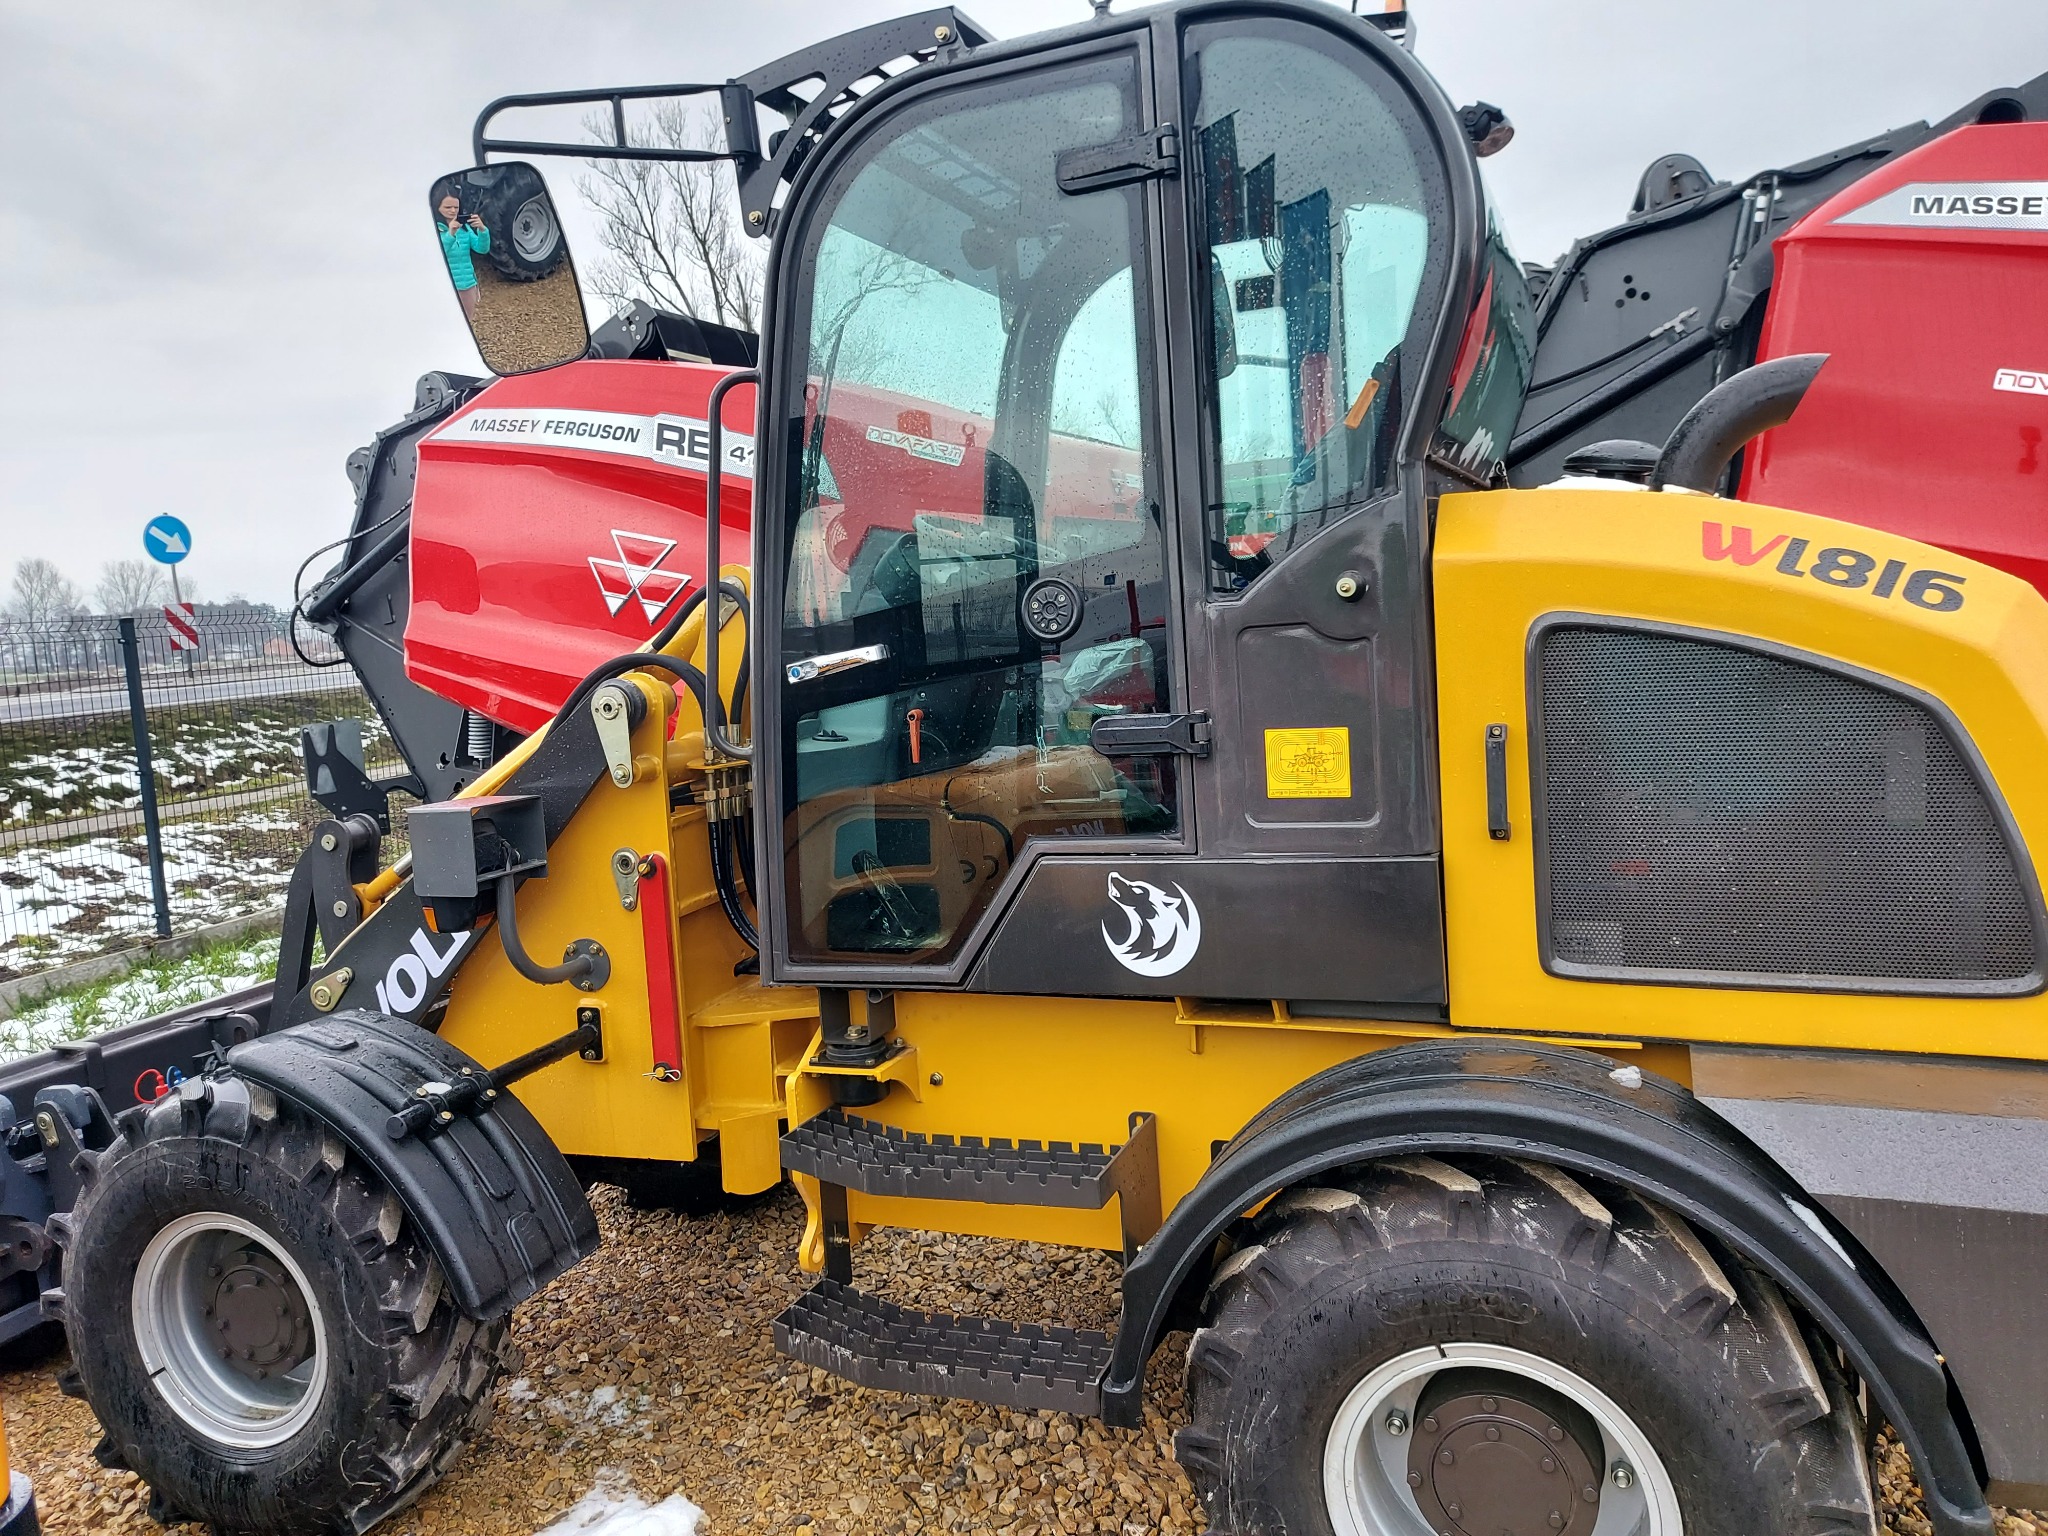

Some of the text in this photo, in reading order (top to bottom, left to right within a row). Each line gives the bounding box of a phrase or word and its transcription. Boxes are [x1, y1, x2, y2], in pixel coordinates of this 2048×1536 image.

[1912, 196, 2048, 216] MASSE
[469, 418, 542, 434] MASSEY
[542, 420, 641, 444] FERGUSON
[1701, 520, 1968, 613] WL816
